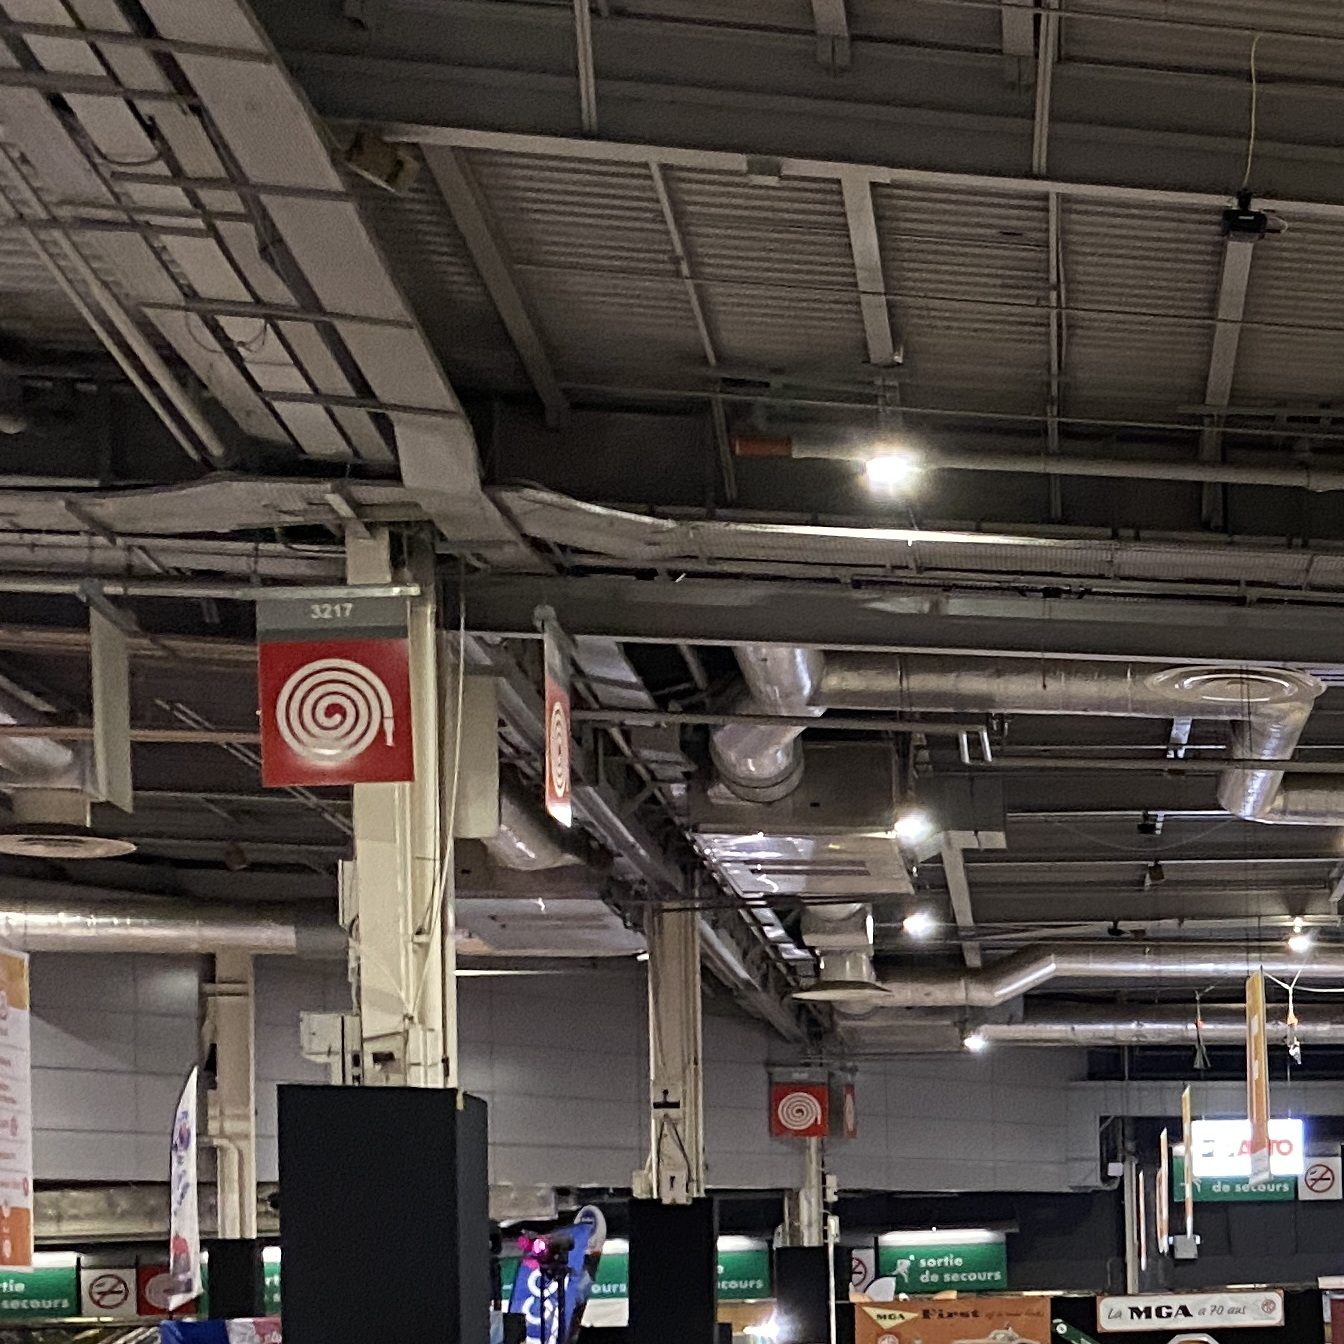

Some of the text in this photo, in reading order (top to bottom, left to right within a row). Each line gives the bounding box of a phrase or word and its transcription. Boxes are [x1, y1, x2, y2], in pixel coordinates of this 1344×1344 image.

[310, 602, 354, 619] 3217
[1237, 1139, 1293, 1157] ATO
[1212, 1181, 1232, 1193] de
[919, 1254, 964, 1268] sortie
[919, 1270, 1002, 1284] de secours
[876, 1312, 906, 1321] MGA
[922, 1308, 980, 1320] First
[1107, 1307, 1122, 1320] La
[1128, 1304, 1193, 1320] MGA
[1209, 1305, 1224, 1317] 70
[1227, 1305, 1247, 1315] ans
